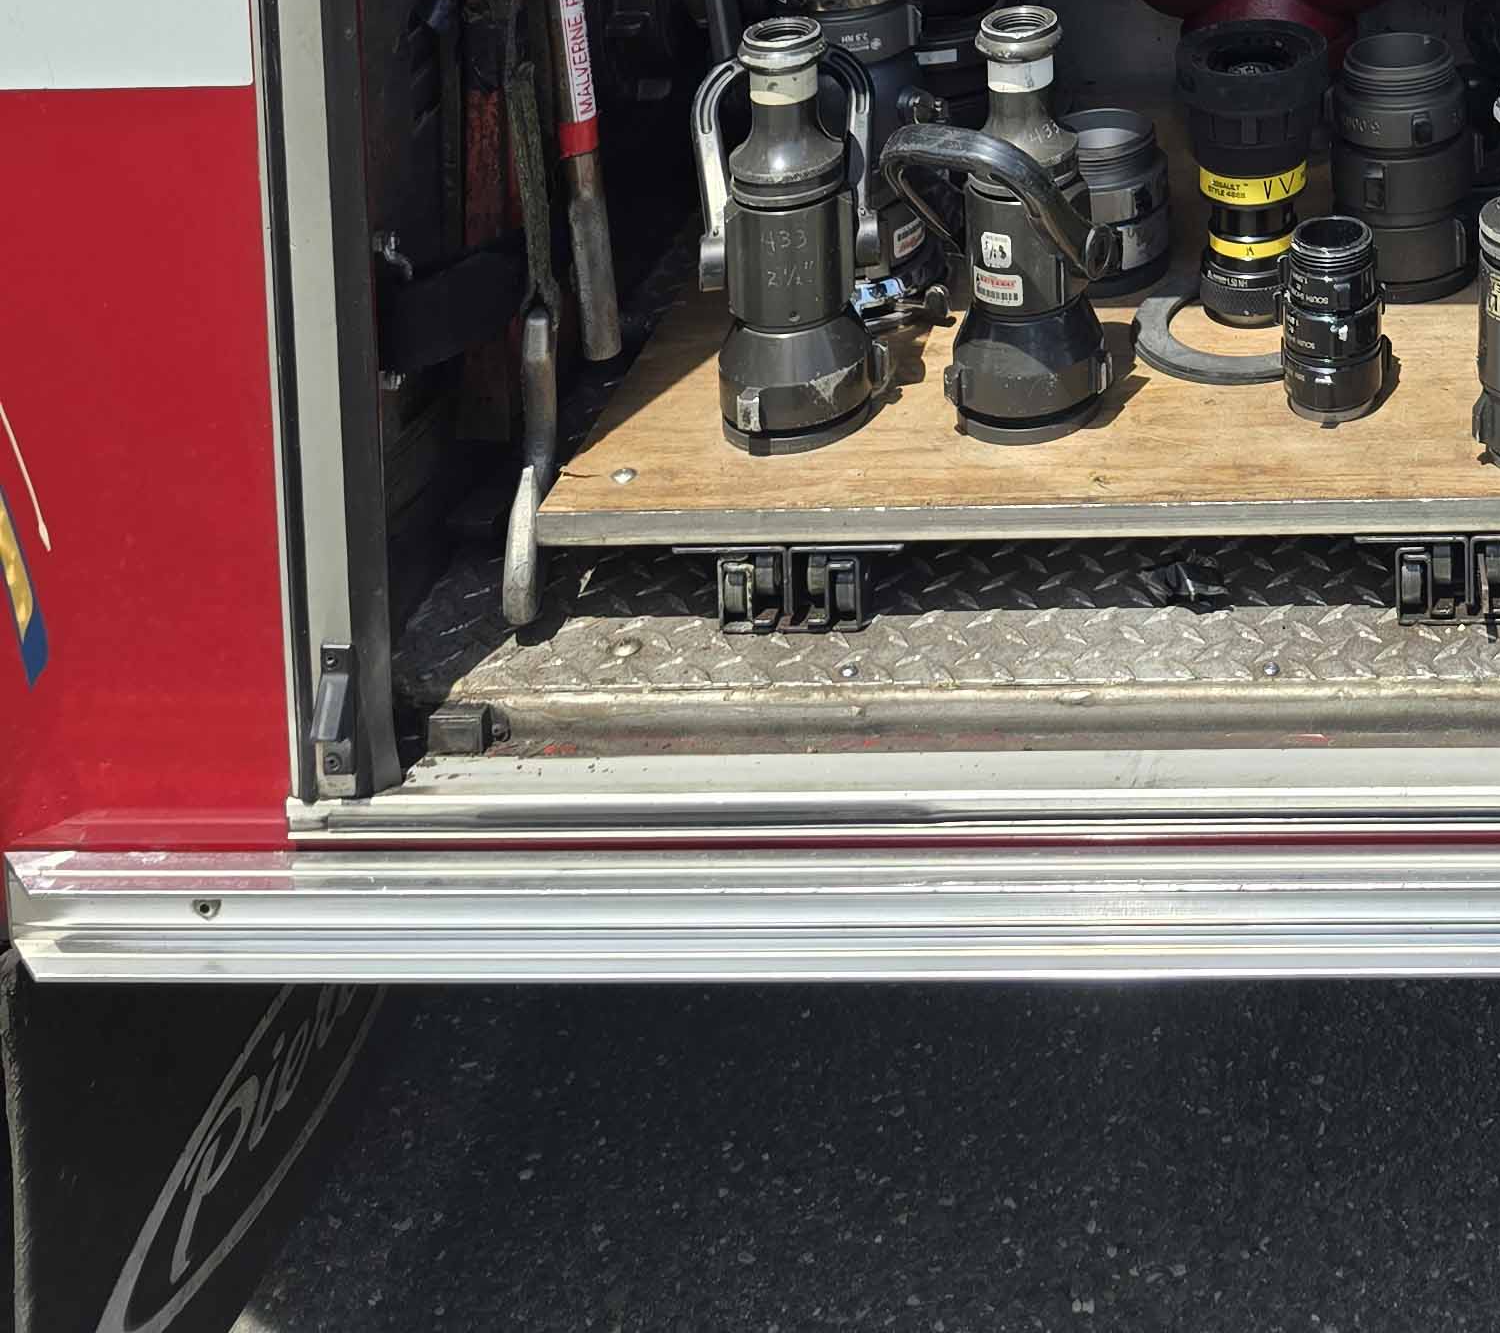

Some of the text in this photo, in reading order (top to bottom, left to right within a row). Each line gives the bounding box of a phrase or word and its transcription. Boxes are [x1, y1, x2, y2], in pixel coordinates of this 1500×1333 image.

[567, 12, 595, 116] MALVERNE
[1030, 121, 1060, 143] 433
[761, 228, 808, 253] 433
